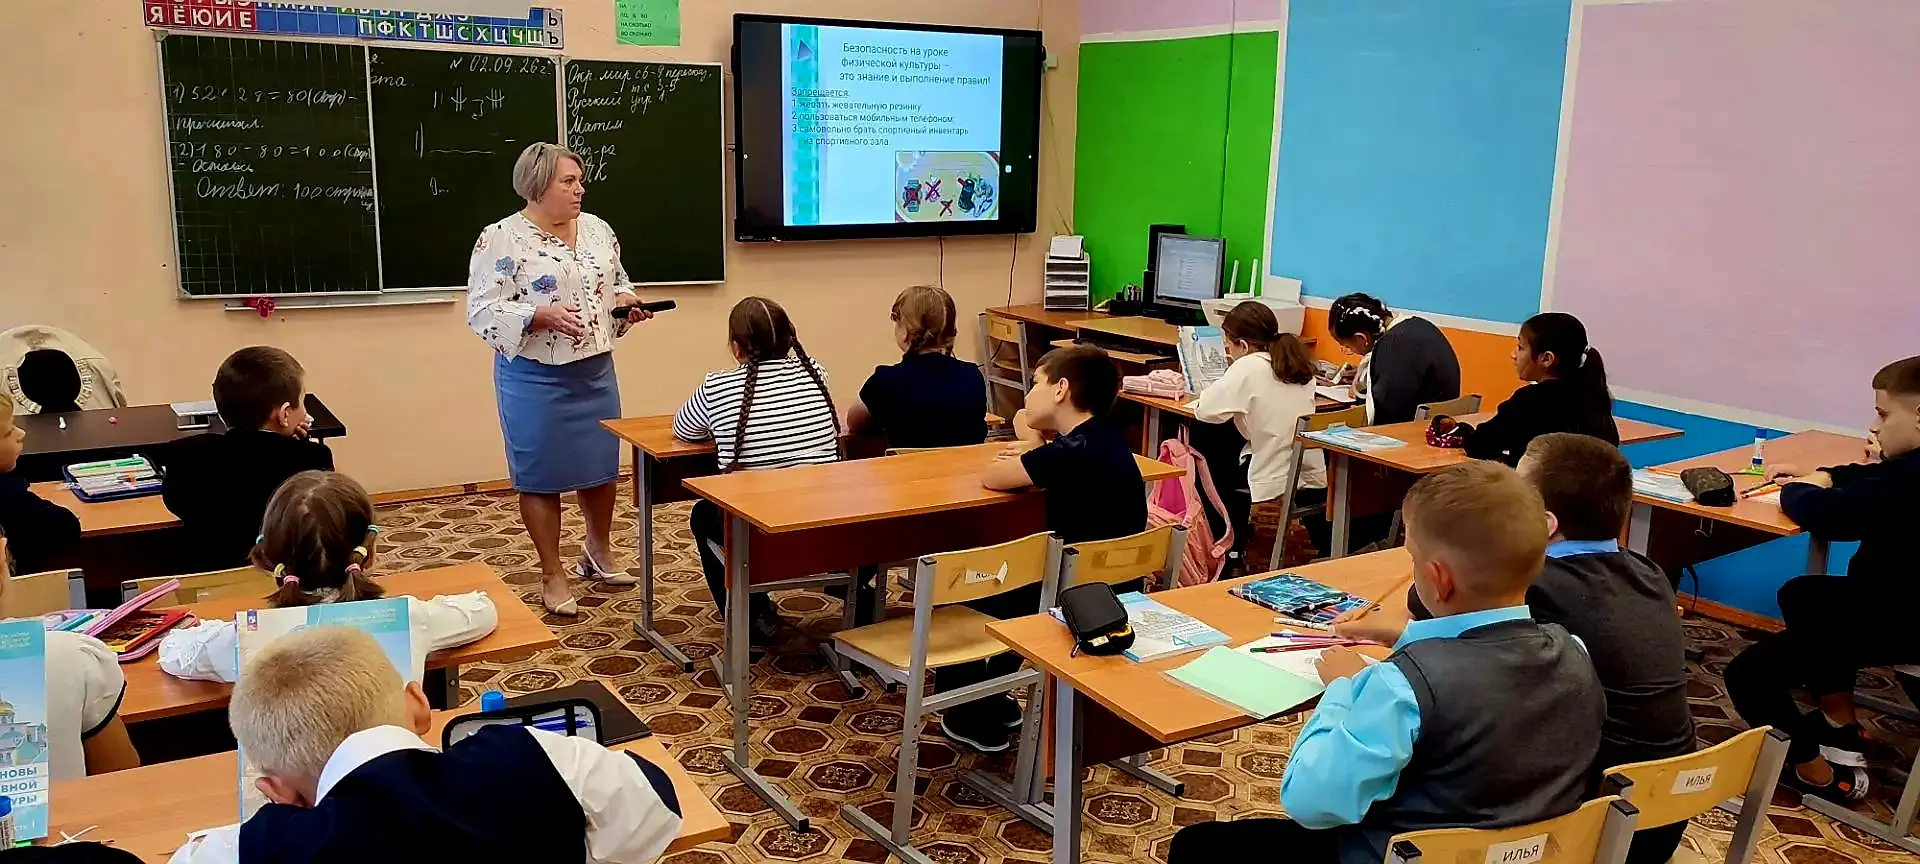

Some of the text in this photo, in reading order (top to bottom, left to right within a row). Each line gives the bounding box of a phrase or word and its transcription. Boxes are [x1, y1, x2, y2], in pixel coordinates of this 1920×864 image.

[843, 43, 949, 58] Безопасность на уроке
[841, 58, 897, 68] физической
[899, 61, 941, 72] культуры
[839, 72, 991, 87] это знание и выполнение правил!
[568, 87, 622, 117] Русский
[832, 101, 887, 111] жевательную
[859, 112, 908, 122] мобильным
[853, 124, 877, 135] брать
[928, 127, 969, 137] инвентарь
[815, 137, 868, 147] спортивного
[1685, 773, 1712, 788] ИЛЬЯ
[1503, 844, 1540, 862] ИЛЬЯ
